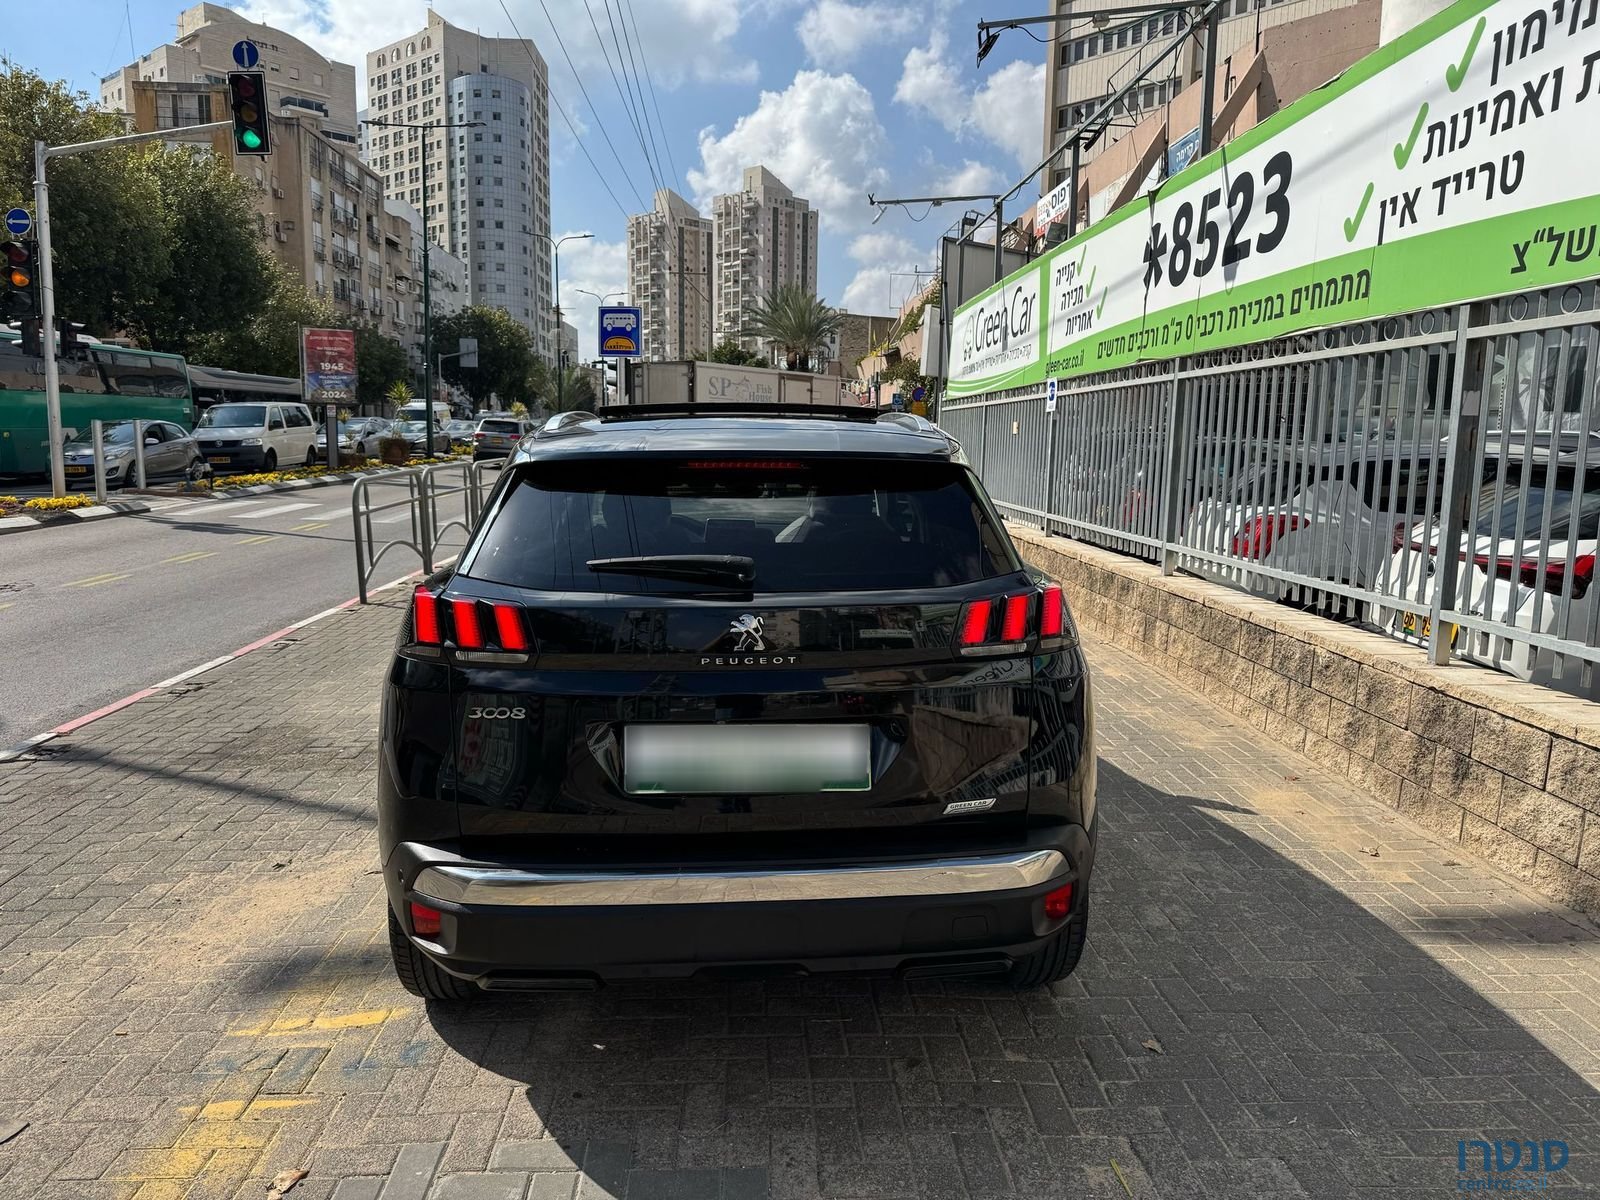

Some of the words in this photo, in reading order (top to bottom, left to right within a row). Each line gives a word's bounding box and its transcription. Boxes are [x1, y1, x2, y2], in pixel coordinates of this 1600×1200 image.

[1490, 0, 1599, 86] מימון
[1422, 66, 1565, 163] ואמינות
[1432, 149, 1525, 216] טרייד
[1377, 186, 1422, 246] אין
[1510, 224, 1600, 274] של"צ
[1056, 261, 1076, 286] קנייה
[1061, 285, 1084, 311] מכירה
[1290, 269, 1370, 315] מתמחים
[975, 306, 1009, 352] Green
[1011, 285, 1036, 338] Car
[1065, 309, 1094, 336] אחריות
[1196, 309, 1224, 338] רכבי
[1227, 293, 1284, 331] במכירת
[1127, 326, 1159, 353] ורכבים
[1186, 313, 1194, 341] 0
[1096, 338, 1126, 360] חדשים
[319, 362, 344, 371] 1945
[1045, 349, 1085, 378] green-car.co.il
[321, 391, 347, 399] 2024
[708, 375, 732, 397] SP
[748, 391, 773, 402] House
[756, 383, 773, 394] Fish
[701, 656, 797, 665] PEUGEOT
[468, 707, 526, 719] 3008
